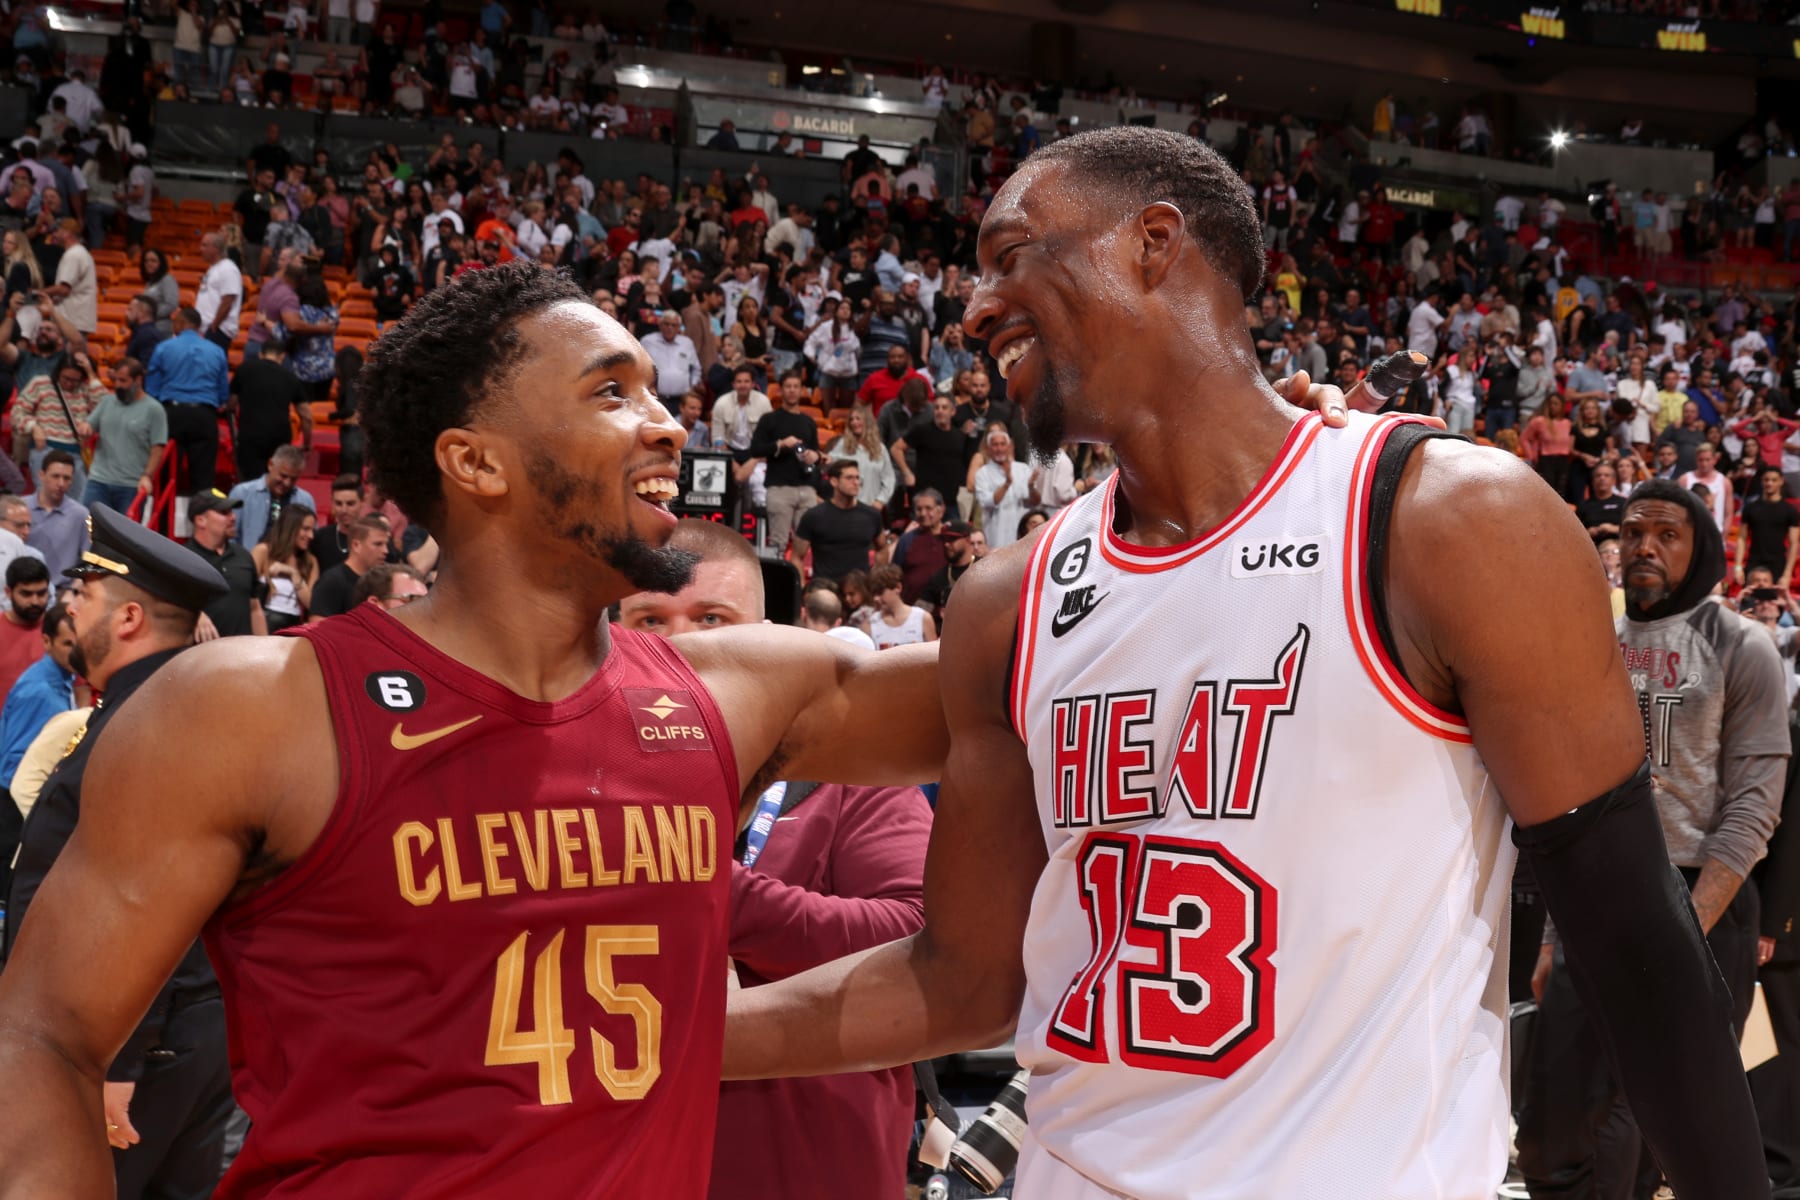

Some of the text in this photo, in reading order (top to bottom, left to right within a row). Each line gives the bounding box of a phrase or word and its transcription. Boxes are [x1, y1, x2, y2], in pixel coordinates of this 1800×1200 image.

[1521, 13, 1565, 39] WIN
[1657, 30, 1706, 52] WIN
[1059, 544, 1087, 579] 6
[1058, 584, 1097, 618] NIKE
[1620, 643, 1681, 689] MOS
[377, 676, 415, 708] 6
[640, 726, 705, 741] CLIFFS
[1051, 622, 1311, 828] HEAT
[392, 805, 717, 906] CLEVELAND
[1046, 831, 1278, 1080] 13
[484, 924, 662, 1106] 45
